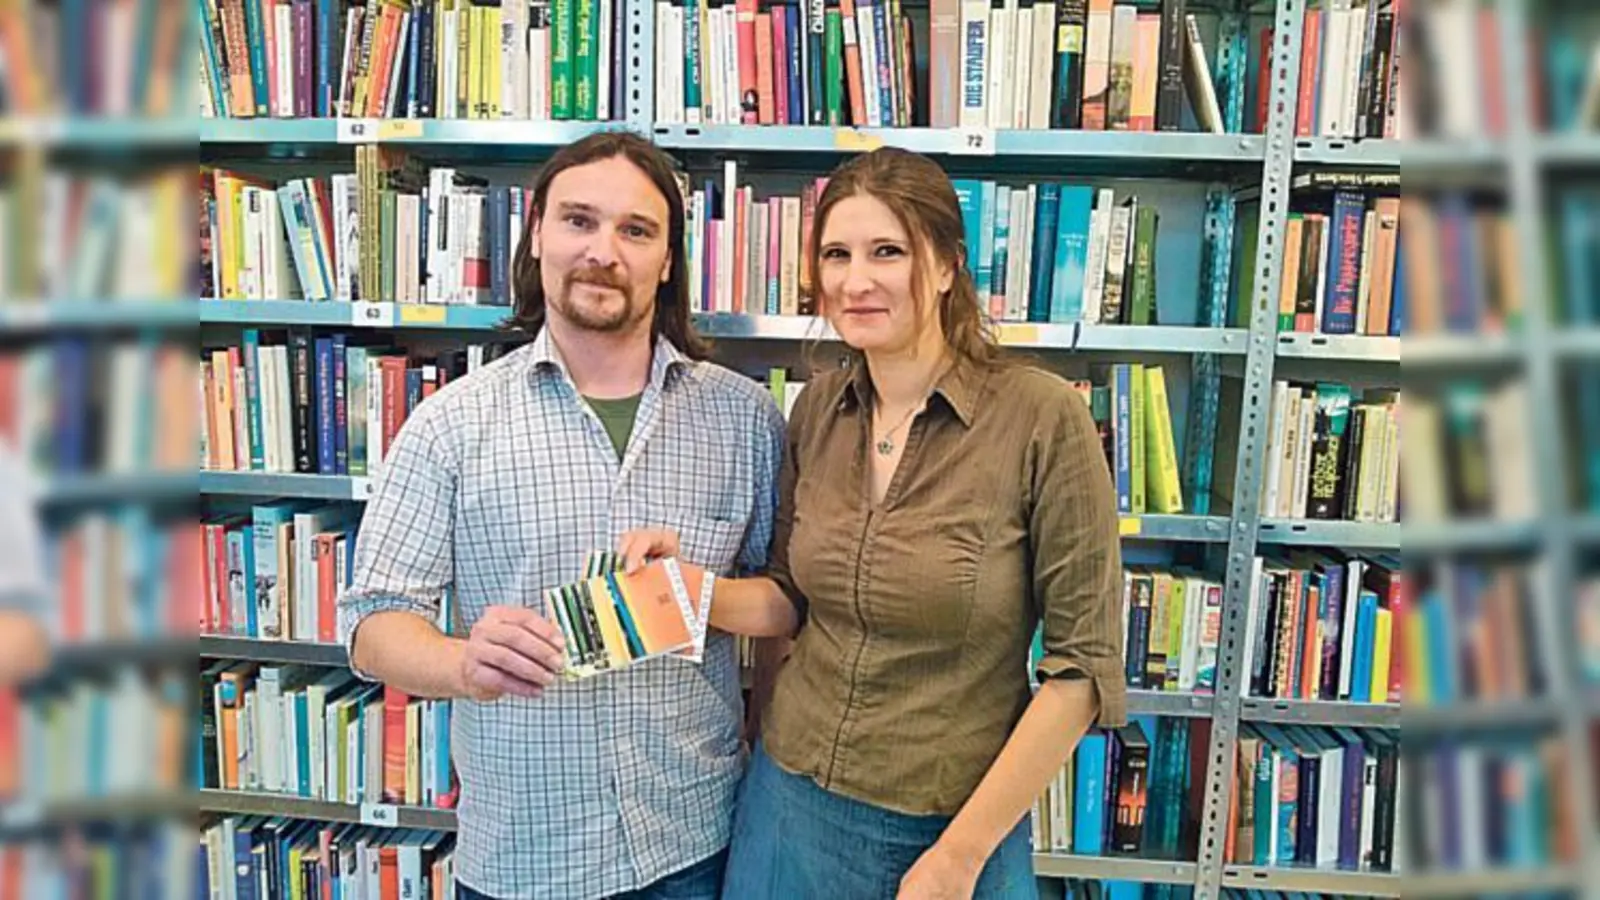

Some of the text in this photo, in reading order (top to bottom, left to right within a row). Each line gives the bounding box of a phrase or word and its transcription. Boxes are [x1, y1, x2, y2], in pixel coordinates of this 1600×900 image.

[965, 20, 984, 108] DIE STAUFER
[351, 123, 364, 135] 62
[967, 134, 983, 148] 72
[366, 307, 380, 319] 63
[373, 809, 387, 820] 66
